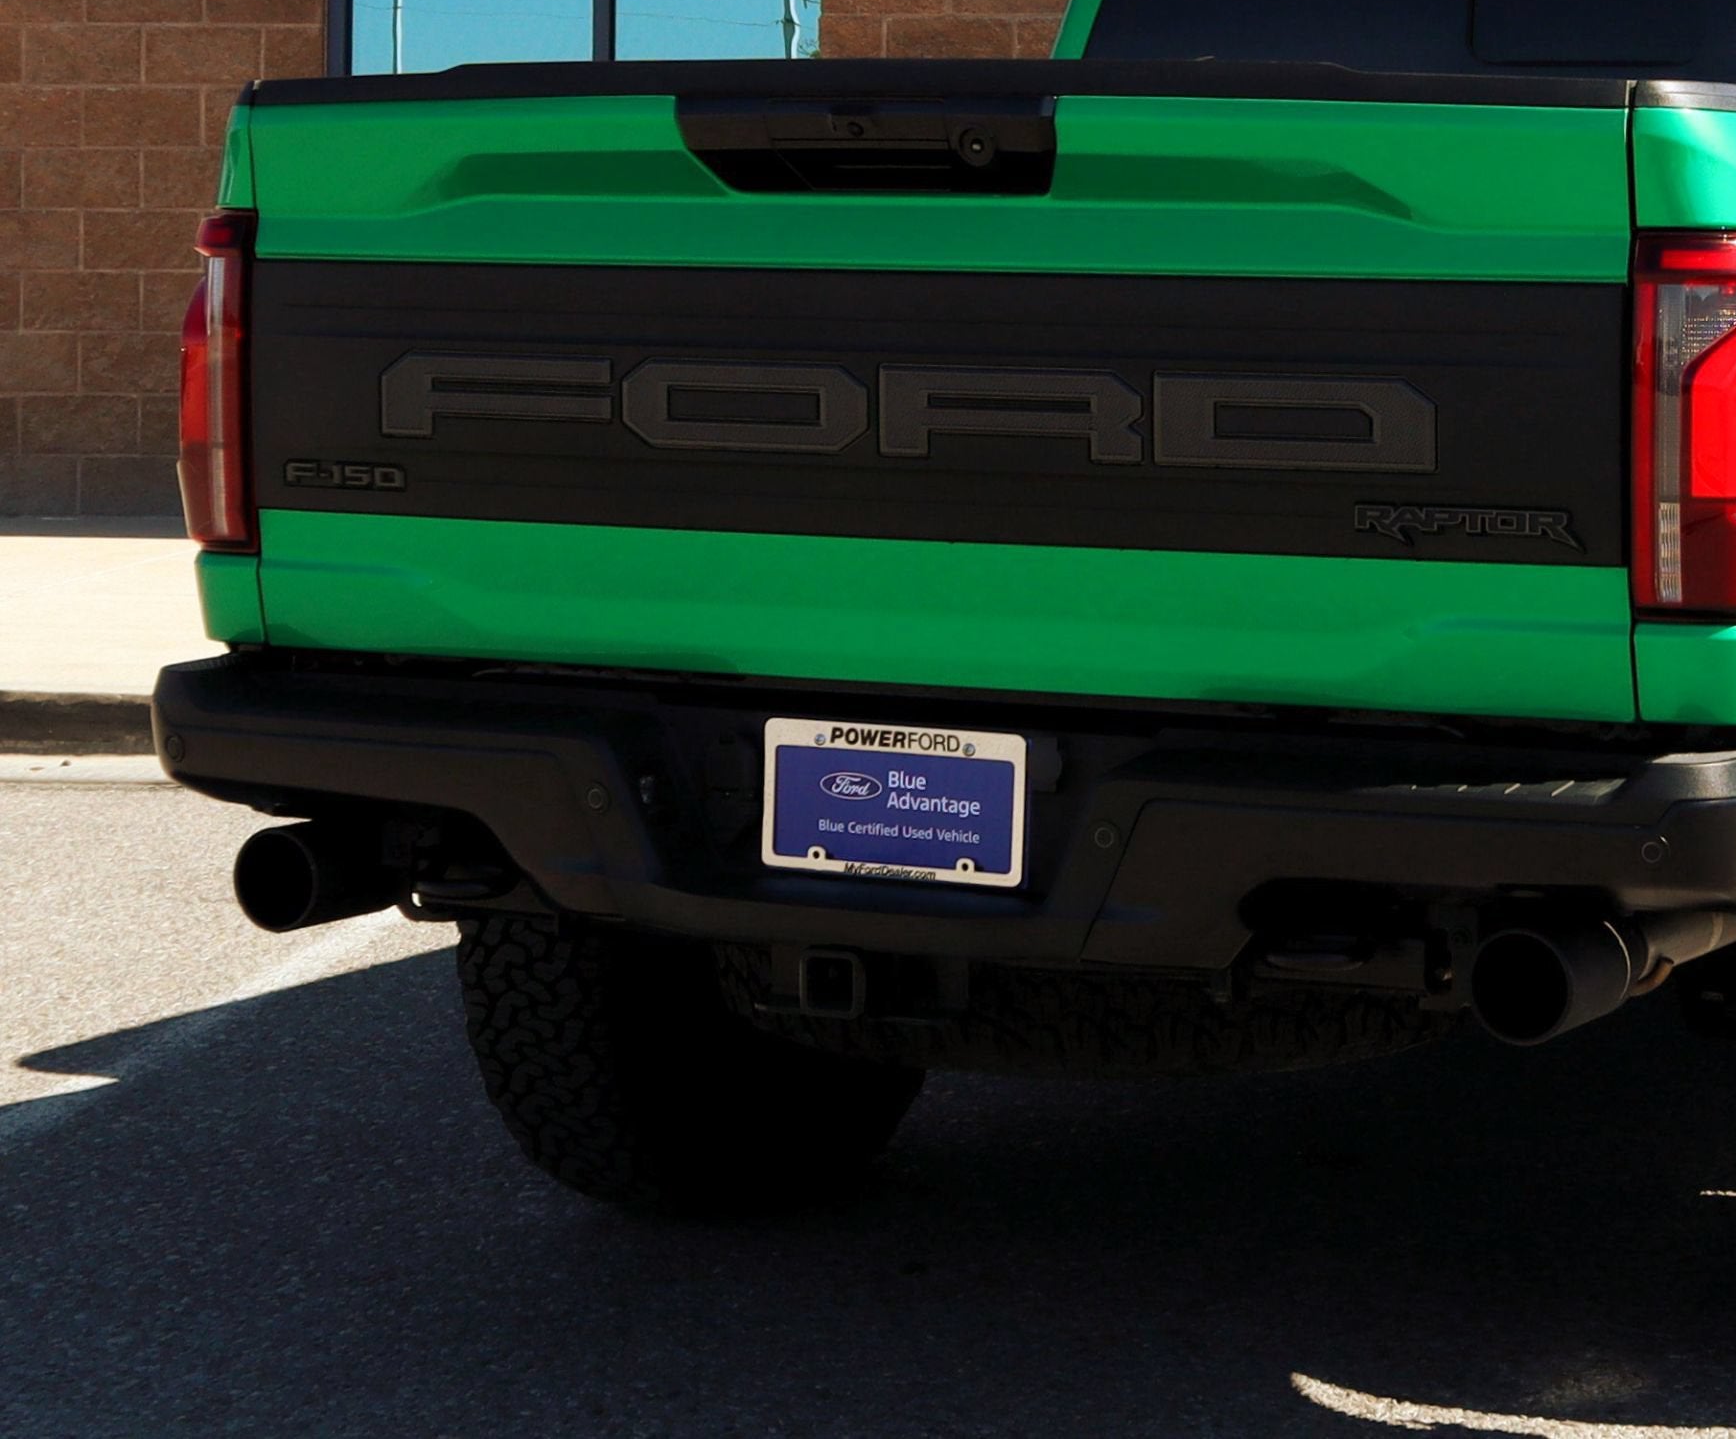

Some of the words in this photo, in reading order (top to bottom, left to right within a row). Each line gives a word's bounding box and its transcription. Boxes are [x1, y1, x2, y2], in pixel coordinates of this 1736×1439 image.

[378, 347, 1438, 474] FORD
[284, 458, 407, 492] F-150
[1354, 501, 1587, 554] RAPTOR
[829, 726, 961, 753] POWERFORD
[831, 773, 871, 796] Ford
[887, 770, 927, 791] Blue
[886, 791, 981, 818] Advantage
[818, 819, 845, 834] Blue
[847, 820, 899, 838] Certified
[902, 826, 934, 841] Used
[936, 828, 981, 845] Vehicle
